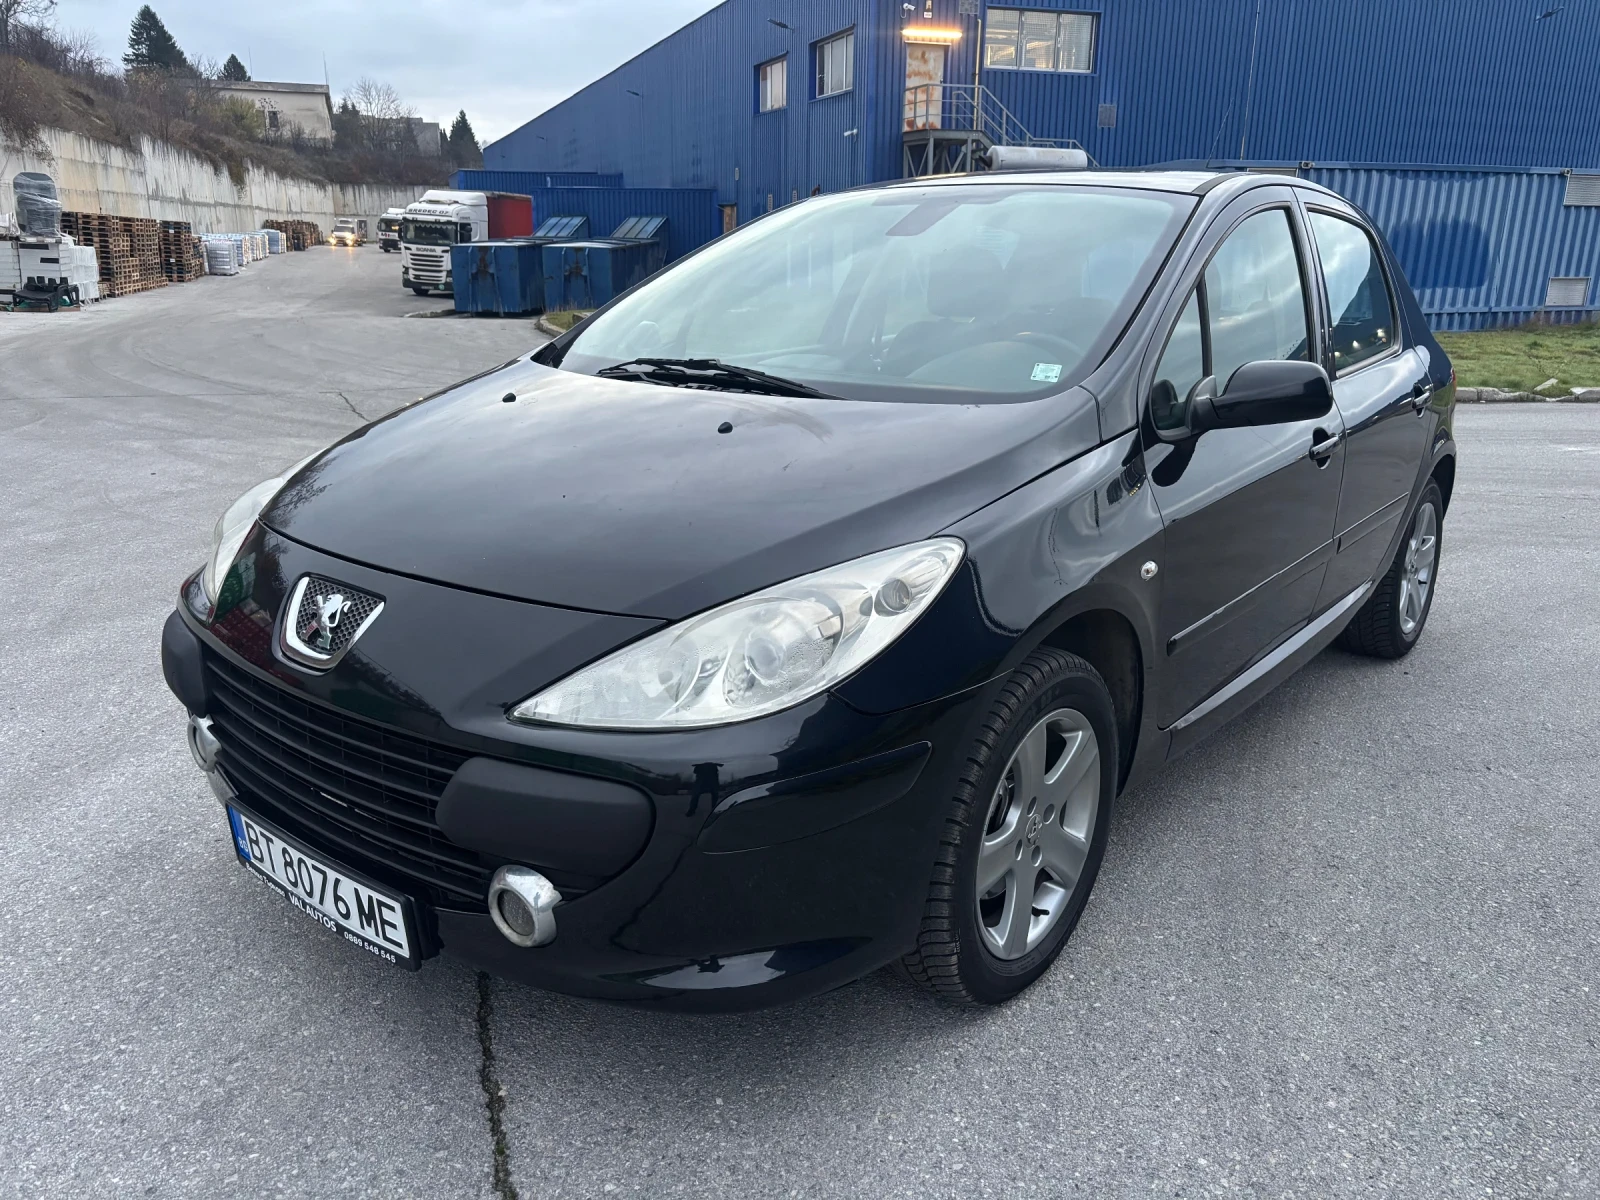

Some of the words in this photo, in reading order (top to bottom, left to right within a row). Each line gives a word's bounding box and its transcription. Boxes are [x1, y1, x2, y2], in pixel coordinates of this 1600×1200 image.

[244, 819, 277, 874] BT
[281, 846, 351, 921] 8076
[353, 886, 404, 950] ME
[288, 892, 306, 912] VAL
[305, 905, 337, 932] AUTOS
[380, 950, 396, 963] 545
